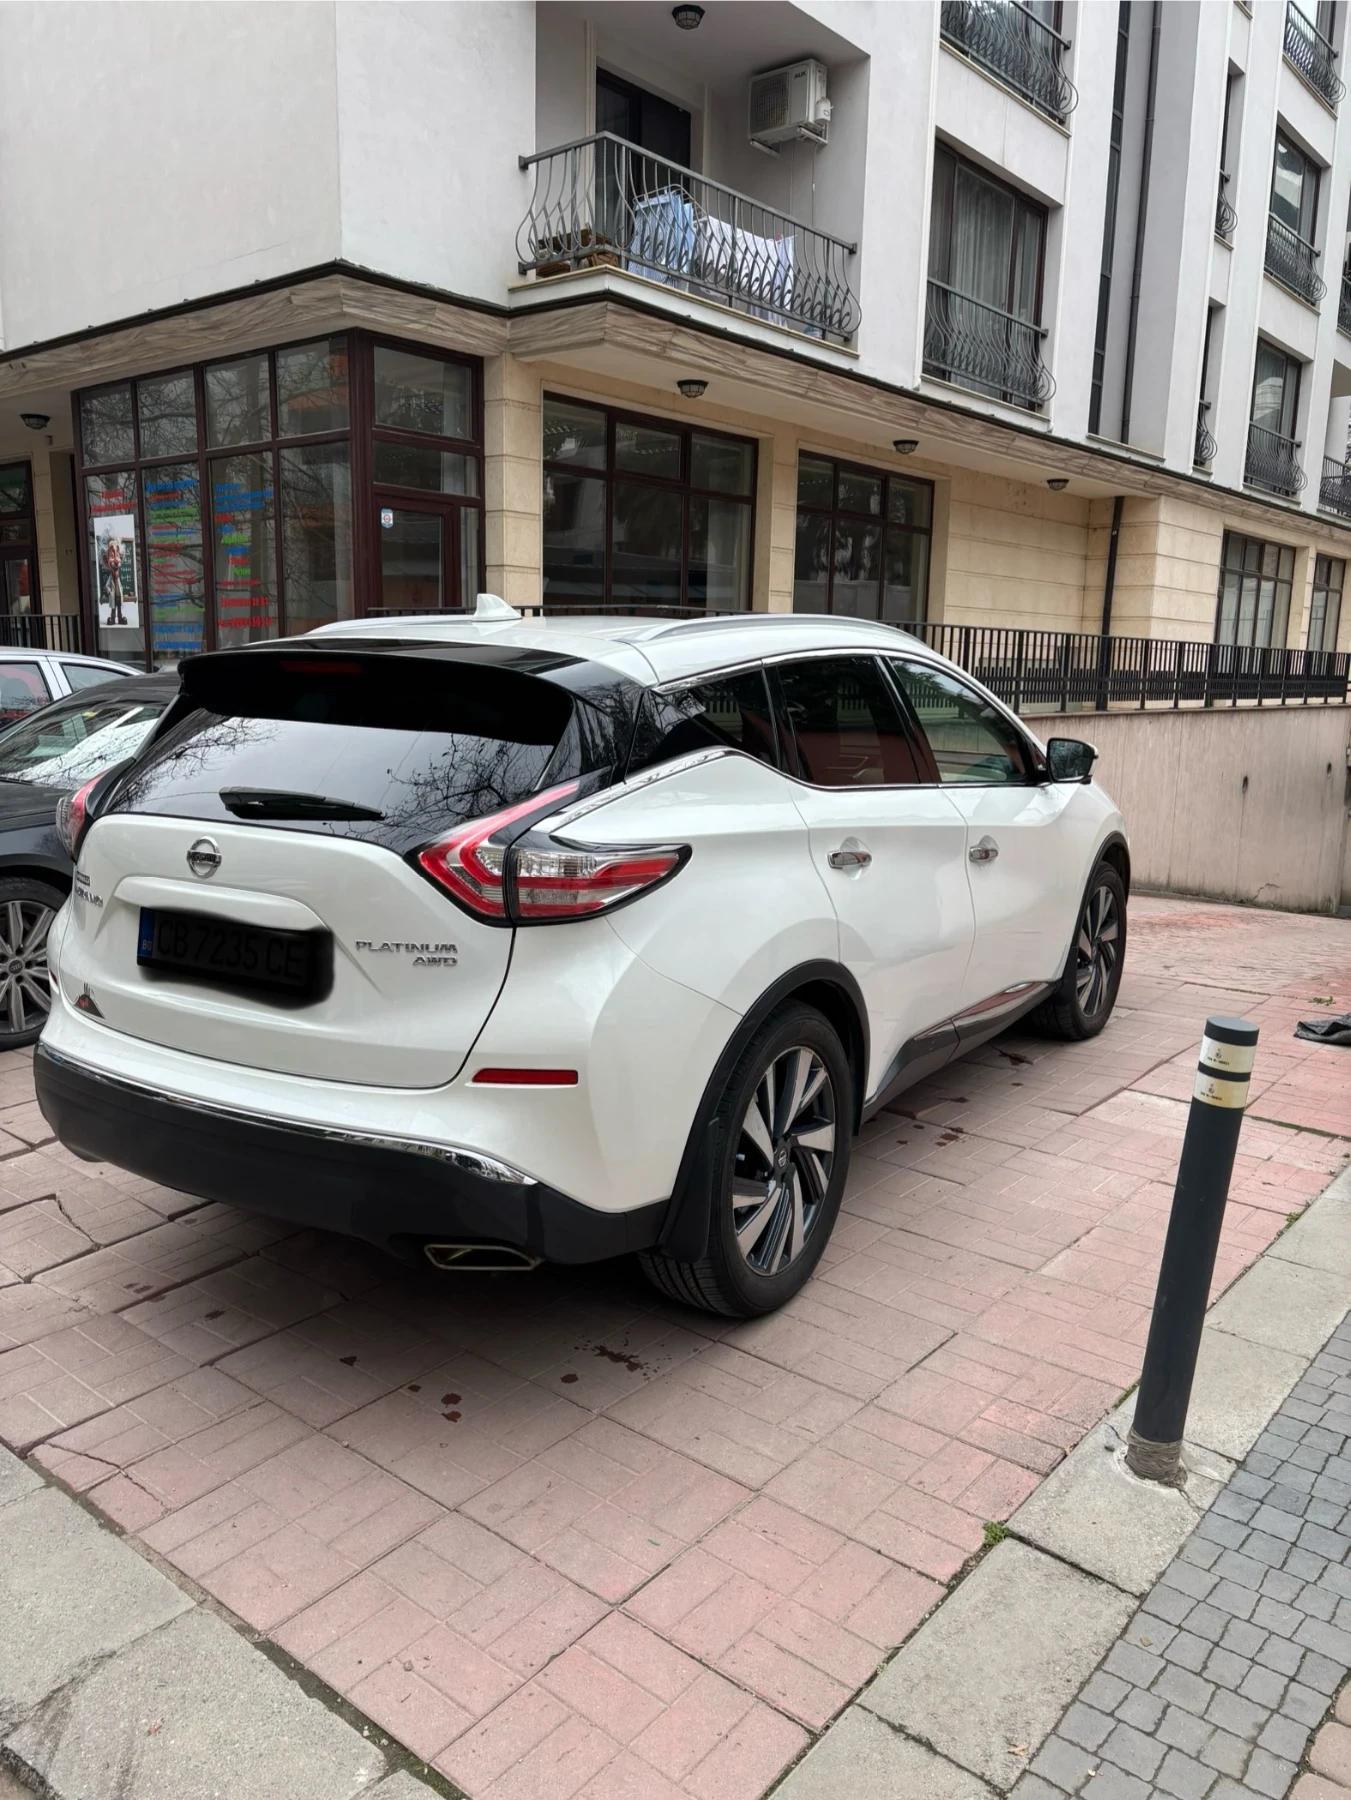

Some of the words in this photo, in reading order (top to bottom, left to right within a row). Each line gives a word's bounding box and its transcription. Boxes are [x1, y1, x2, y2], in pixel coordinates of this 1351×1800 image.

[793, 70, 807, 79] AUX
[142, 939, 153, 951] BG
[157, 920, 188, 959] CB
[194, 924, 261, 971] 7235
[266, 938, 307, 979] CE
[355, 940, 458, 954] PLATINUM
[412, 955, 458, 967] AWD
